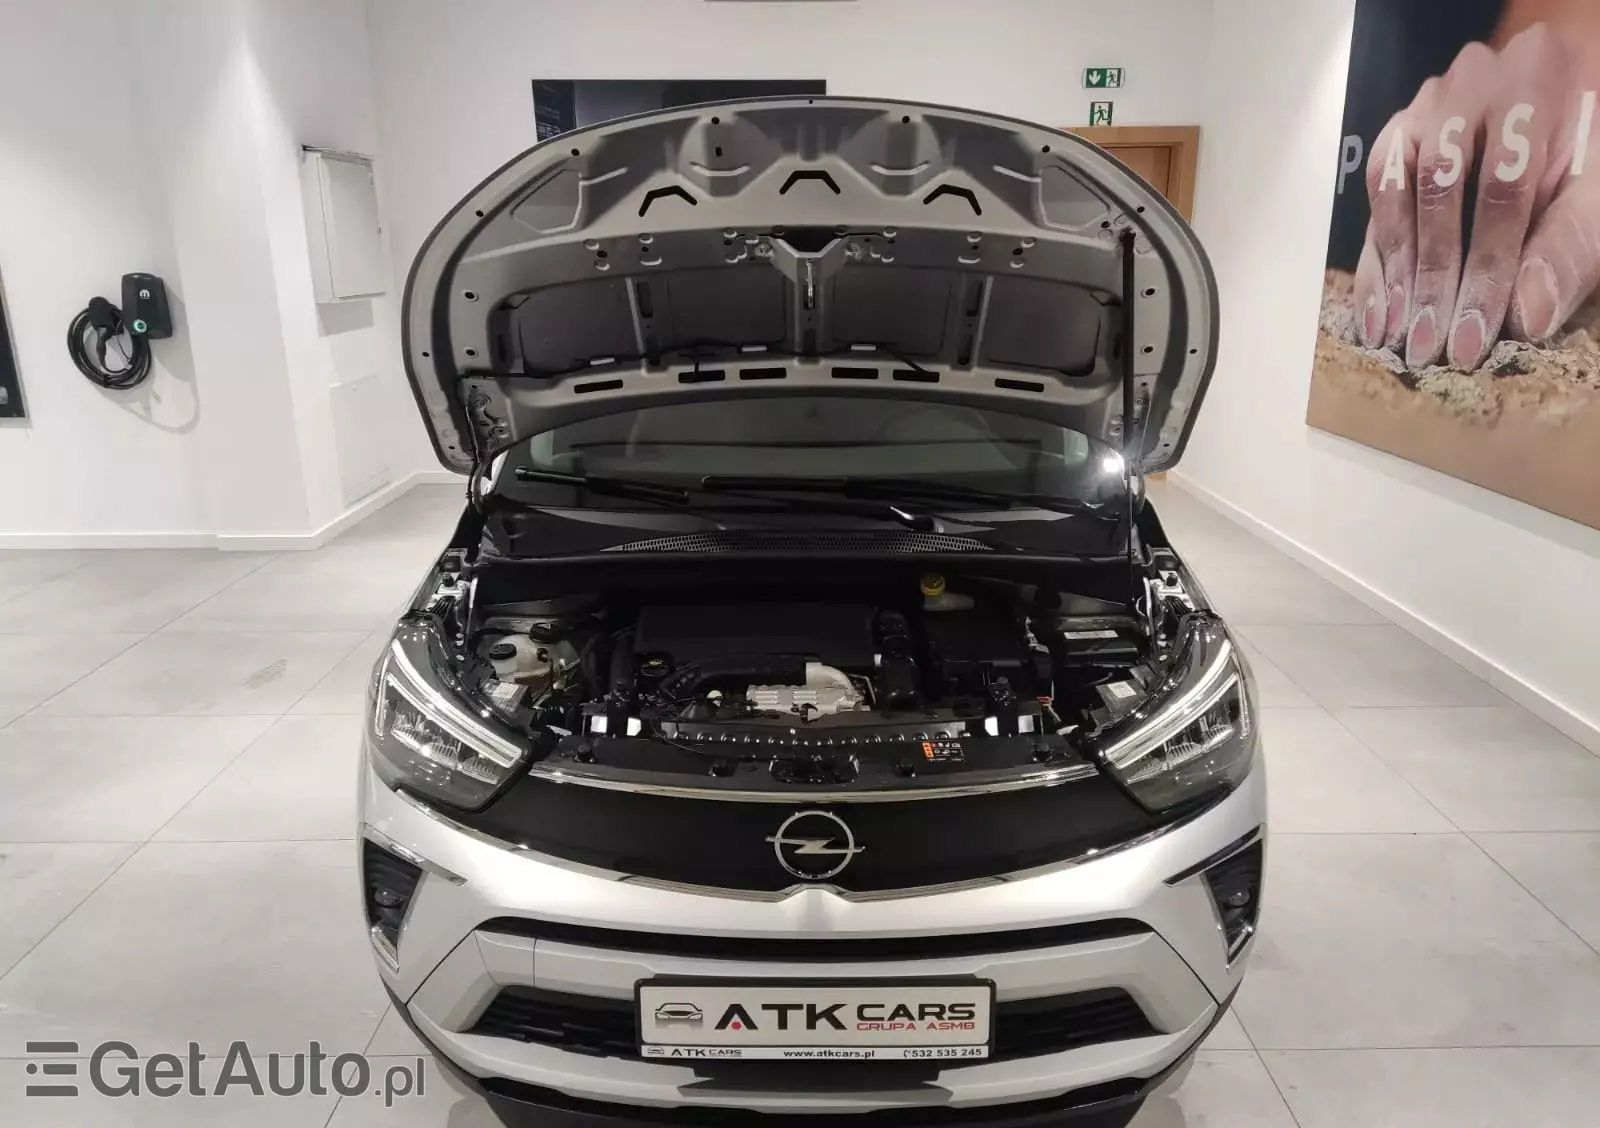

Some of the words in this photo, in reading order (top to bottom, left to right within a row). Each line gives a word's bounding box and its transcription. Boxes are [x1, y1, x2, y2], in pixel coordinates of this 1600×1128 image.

[1337, 90, 1596, 194] PASSI
[714, 1003, 849, 1031] ATK
[856, 1003, 976, 1022] CARS
[856, 1022, 917, 1031] GRUPA
[926, 1021, 976, 1031] ASMB
[670, 1048, 707, 1057] ATK
[708, 1049, 743, 1057] CARS
[783, 1050, 875, 1060] www.atkcars.pl
[936, 1049, 958, 1058] 535
[961, 1048, 983, 1057] 245
